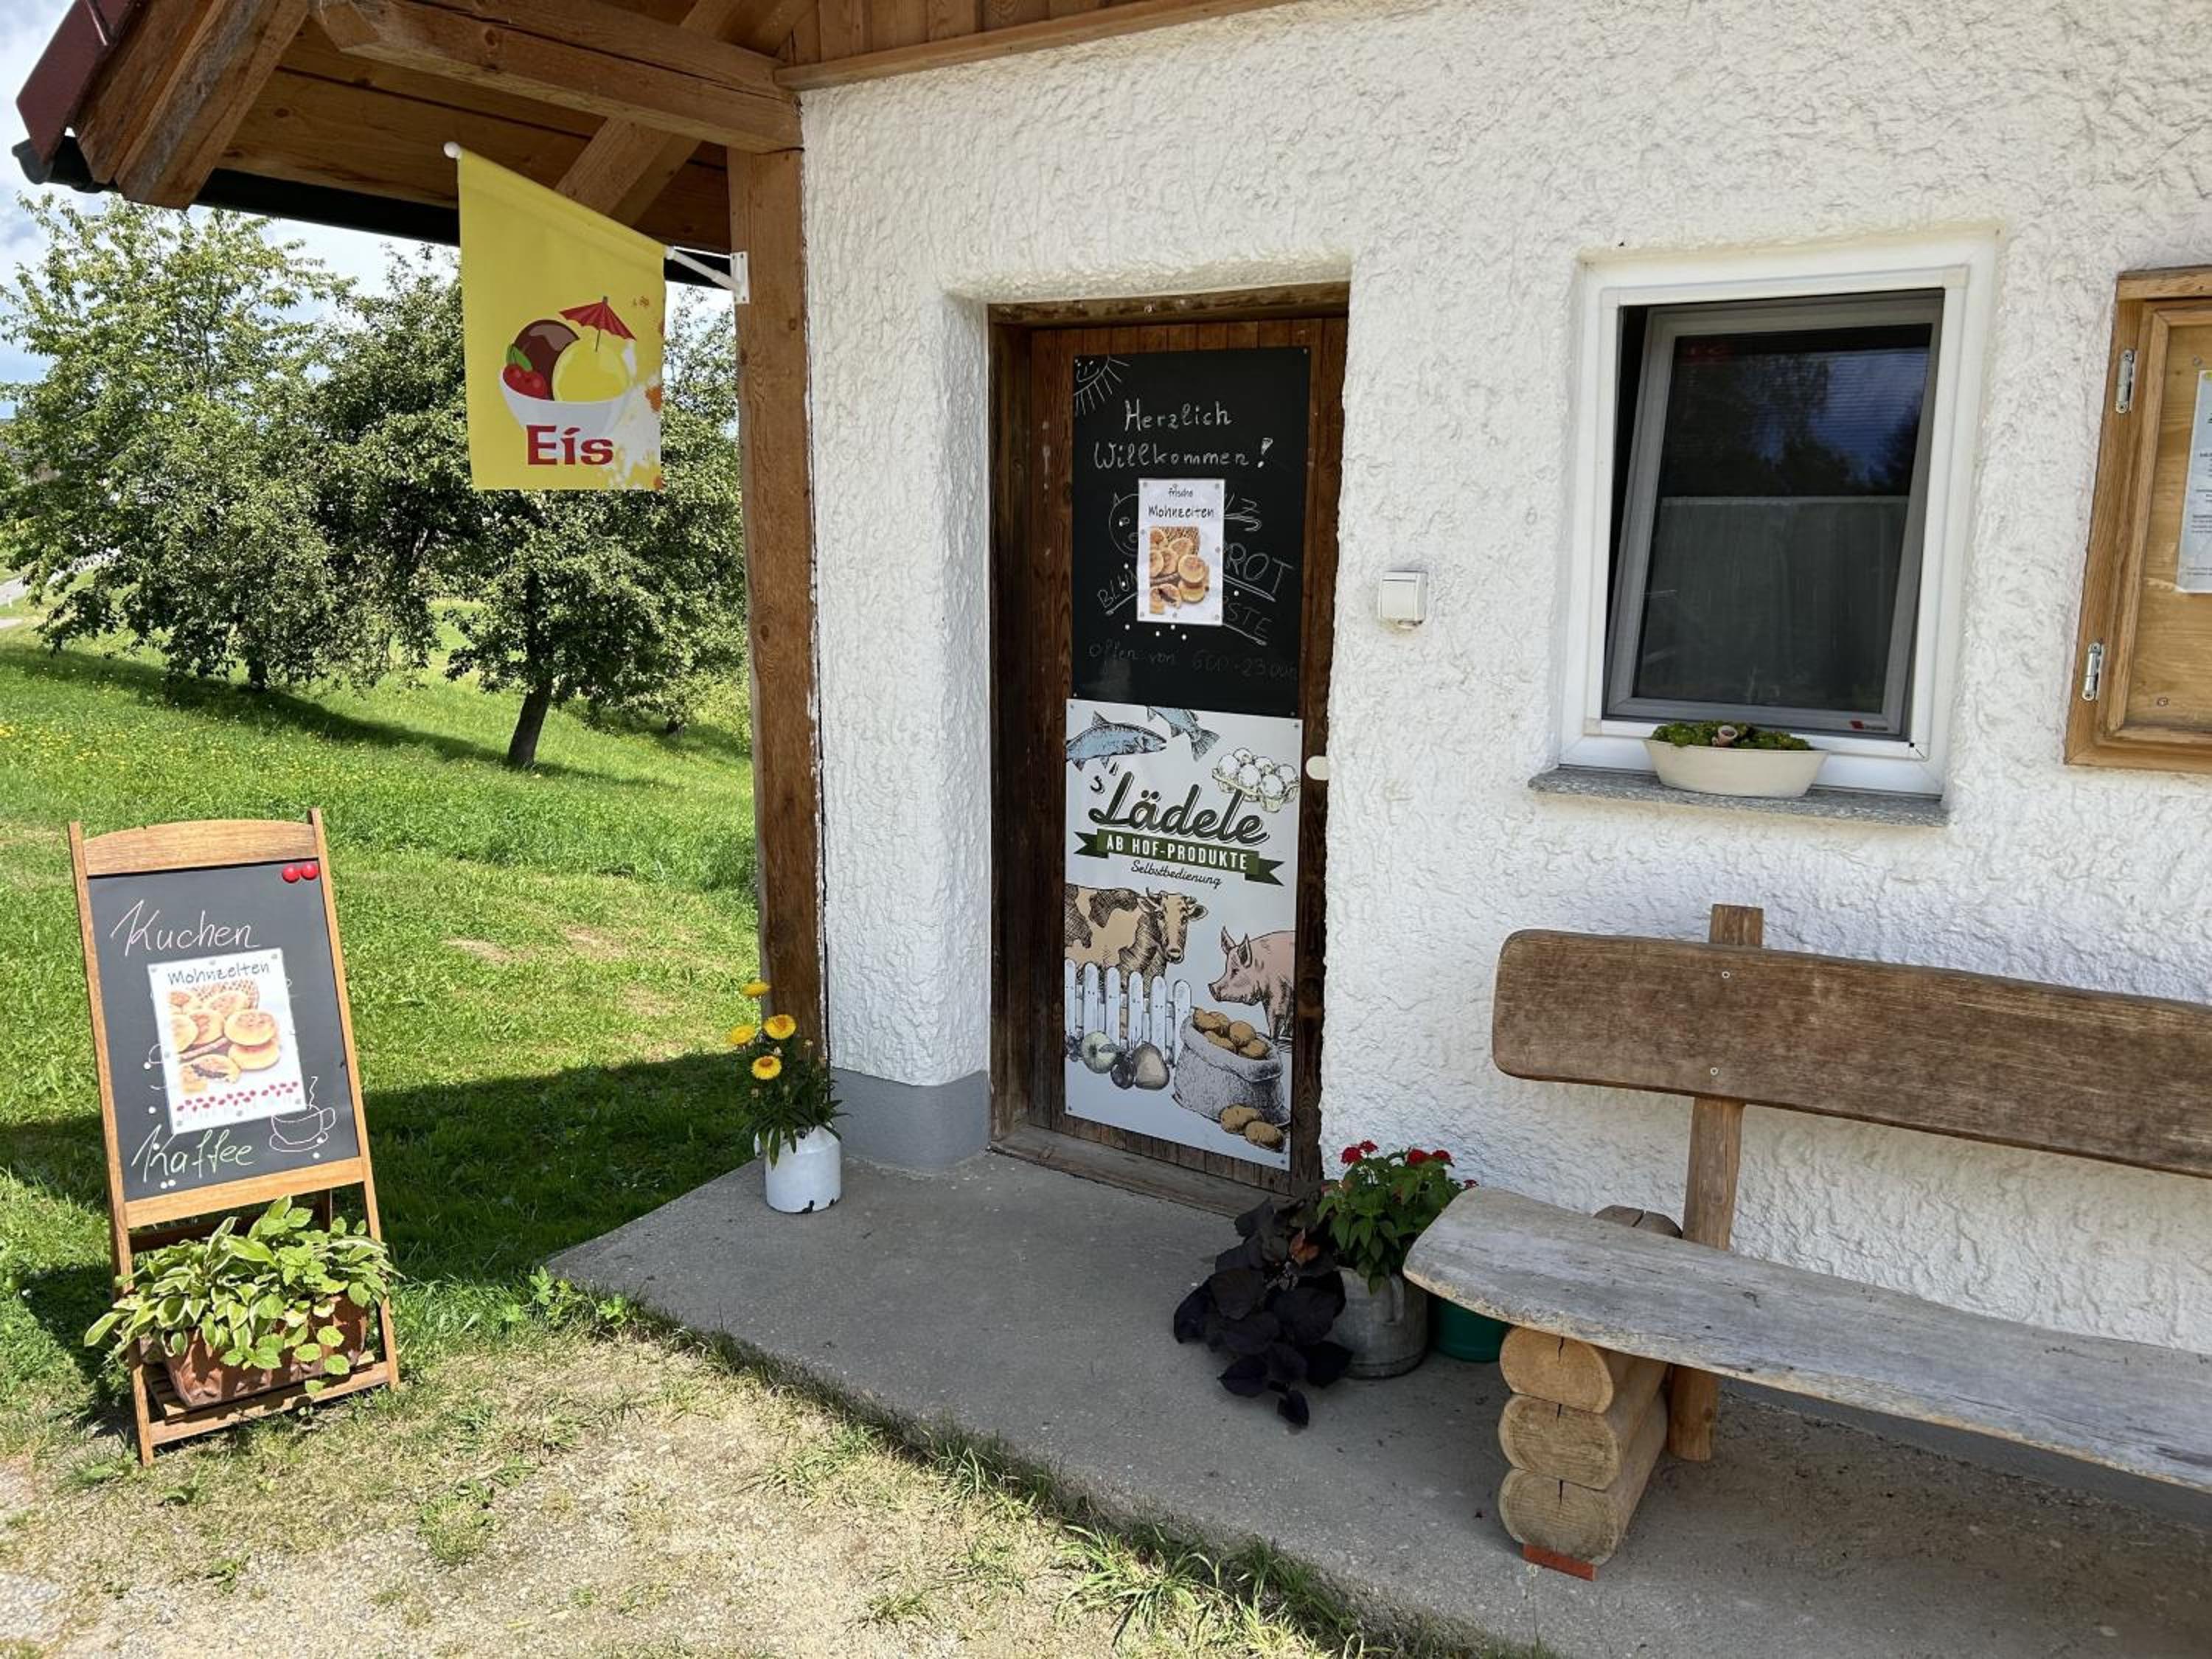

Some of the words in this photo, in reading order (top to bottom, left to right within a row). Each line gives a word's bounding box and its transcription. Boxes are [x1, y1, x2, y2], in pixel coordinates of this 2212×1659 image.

[1124, 397, 1233, 431] Herzlich
[1224, 542, 1295, 595] ROT
[1106, 834, 1124, 852] AB
[1132, 838, 1248, 870] HOF-PRODUKTE
[1130, 859, 1223, 890] Selbstbedienung
[111, 899, 261, 956] Kuchen
[167, 961, 270, 986] Mohnzelten
[131, 1123, 258, 1183] Kaffee
